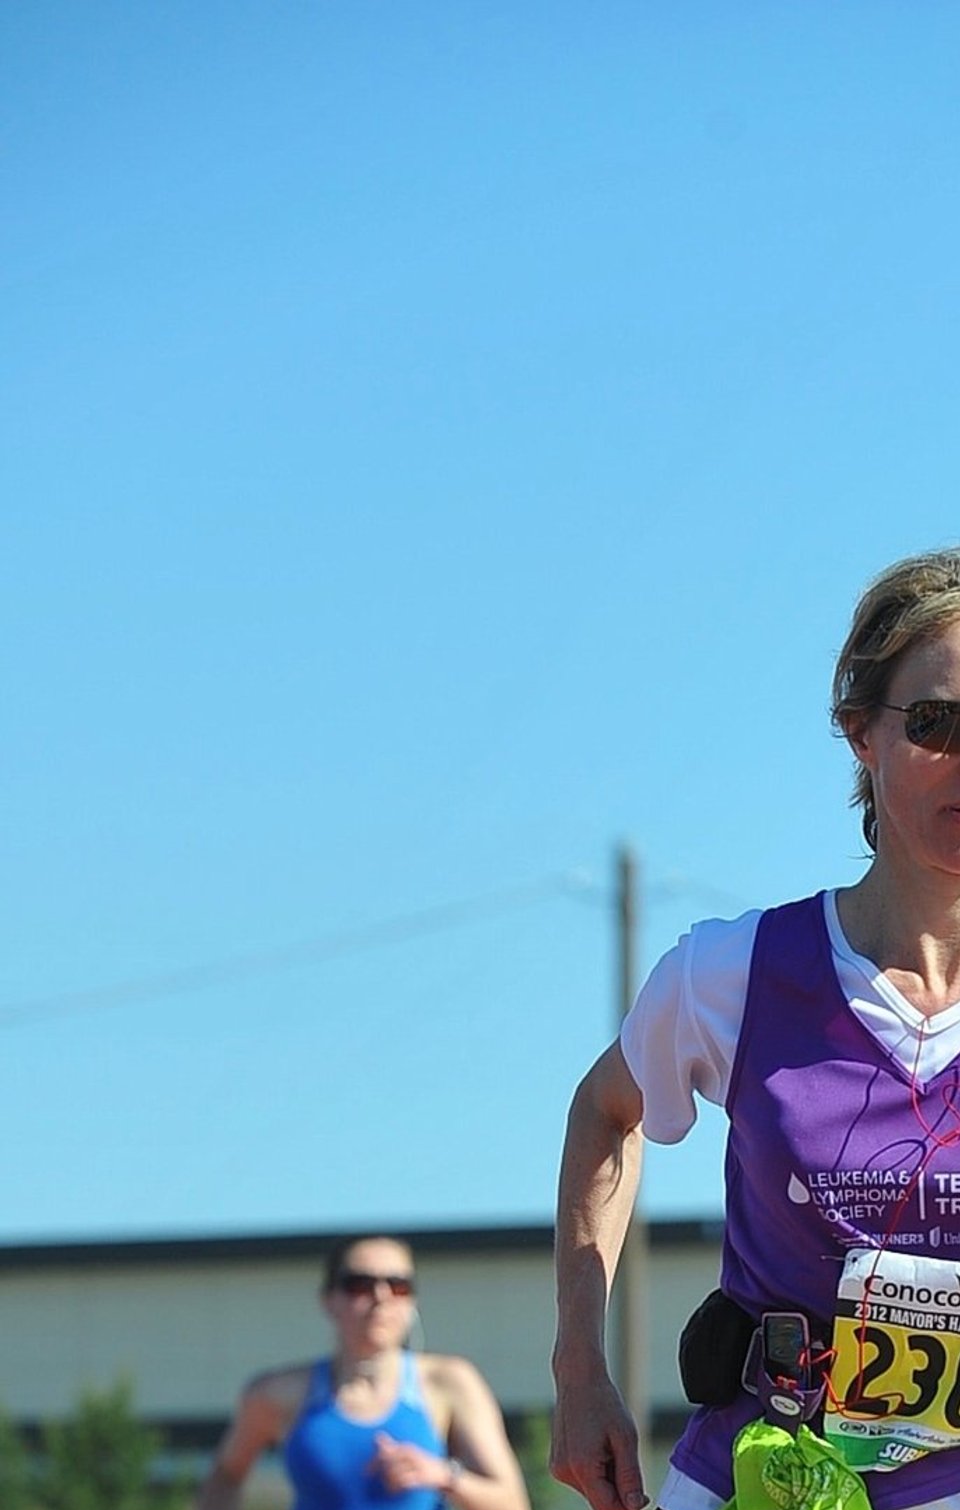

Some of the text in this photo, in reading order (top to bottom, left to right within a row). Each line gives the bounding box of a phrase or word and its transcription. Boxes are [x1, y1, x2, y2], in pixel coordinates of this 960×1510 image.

[808, 1170, 911, 1188] LEUKEMIA &
[811, 1188, 910, 1206] LYMPHOMA
[854, 1303, 887, 1322] 2012
[889, 1308, 946, 1330] MAYOR'S
